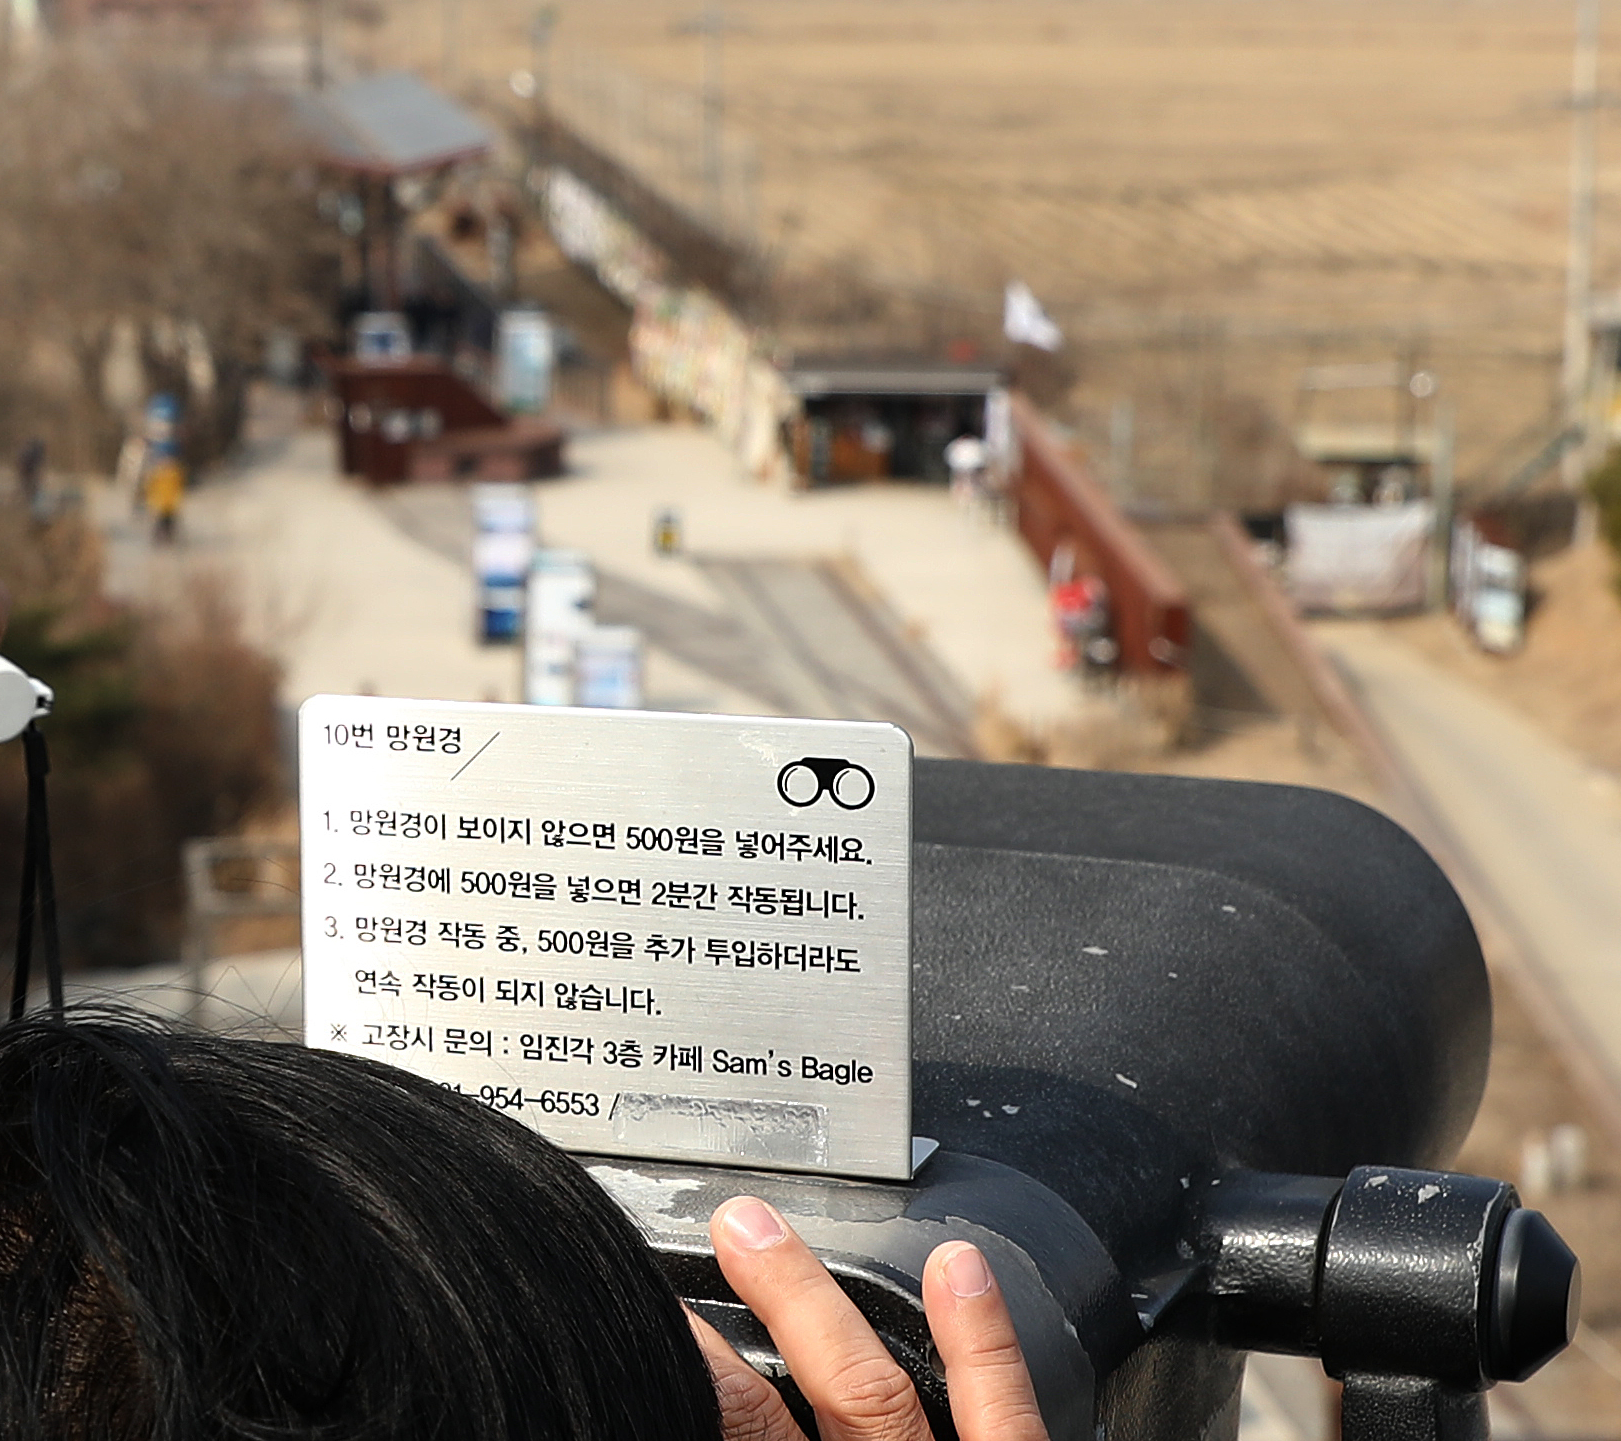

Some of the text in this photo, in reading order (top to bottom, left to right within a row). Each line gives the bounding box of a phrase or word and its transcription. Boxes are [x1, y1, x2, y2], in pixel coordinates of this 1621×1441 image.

[324, 723, 461, 754] 10번 망원경
[324, 809, 872, 865] 1. 망원경이 보이지 않으면 500원을 넣어주세요.
[324, 862, 864, 920] 2. 망원경에 500원을 넣으면 2분간 작동됩니다.
[324, 915, 861, 974] 3. 망원경 작동 중, 500원을 추가 투입하더라도
[355, 969, 662, 1016] 연속 작동이 되지 않습니다.
[362, 1023, 433, 1052] 고장시
[444, 1028, 491, 1057] 문의
[519, 1033, 594, 1065] 임진각
[603, 1040, 642, 1068] 3층
[653, 1043, 703, 1073] 카페
[712, 1049, 792, 1079] Sam's
[802, 1057, 873, 1085] Bagle
